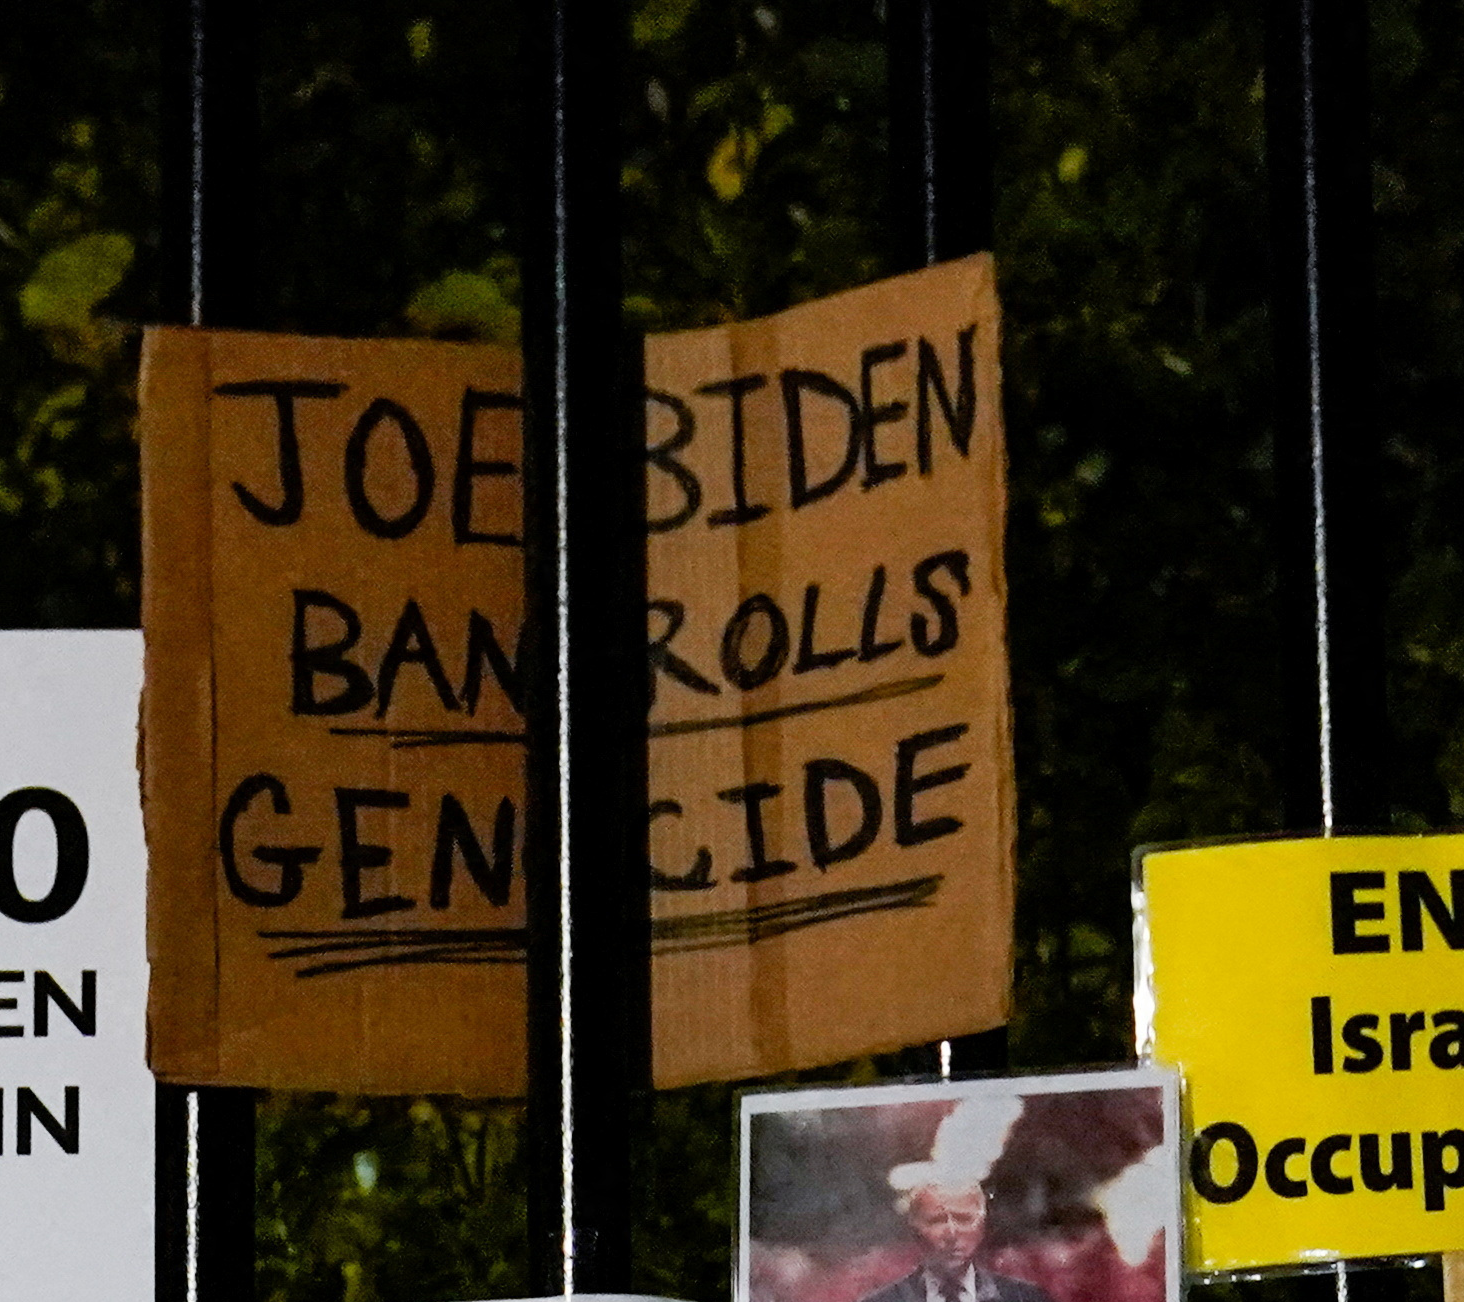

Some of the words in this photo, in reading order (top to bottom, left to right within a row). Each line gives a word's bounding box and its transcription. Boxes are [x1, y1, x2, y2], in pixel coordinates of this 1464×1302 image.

[213, 379, 522, 548] JOE
[646, 323, 978, 534] BIDEN
[290, 549, 971, 720] BANROLLS
[220, 723, 971, 919] GENCIDE
